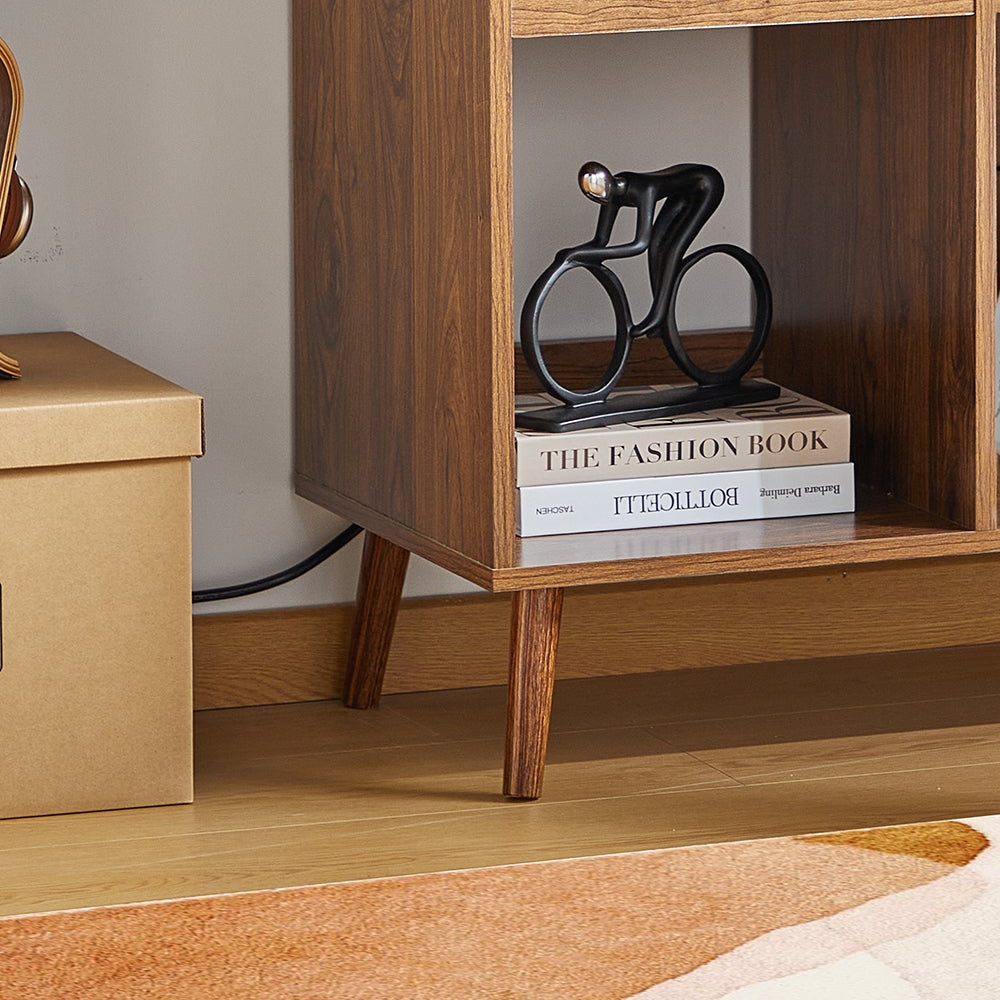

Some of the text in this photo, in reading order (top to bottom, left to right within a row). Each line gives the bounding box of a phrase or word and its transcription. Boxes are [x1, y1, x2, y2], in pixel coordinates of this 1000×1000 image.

[540, 429, 830, 471] THE FASHION BOOK
[613, 486, 740, 516] BOTTICELLI
[759, 483, 841, 499] Barbara Deimling
[535, 505, 575, 516] TASCHEN
